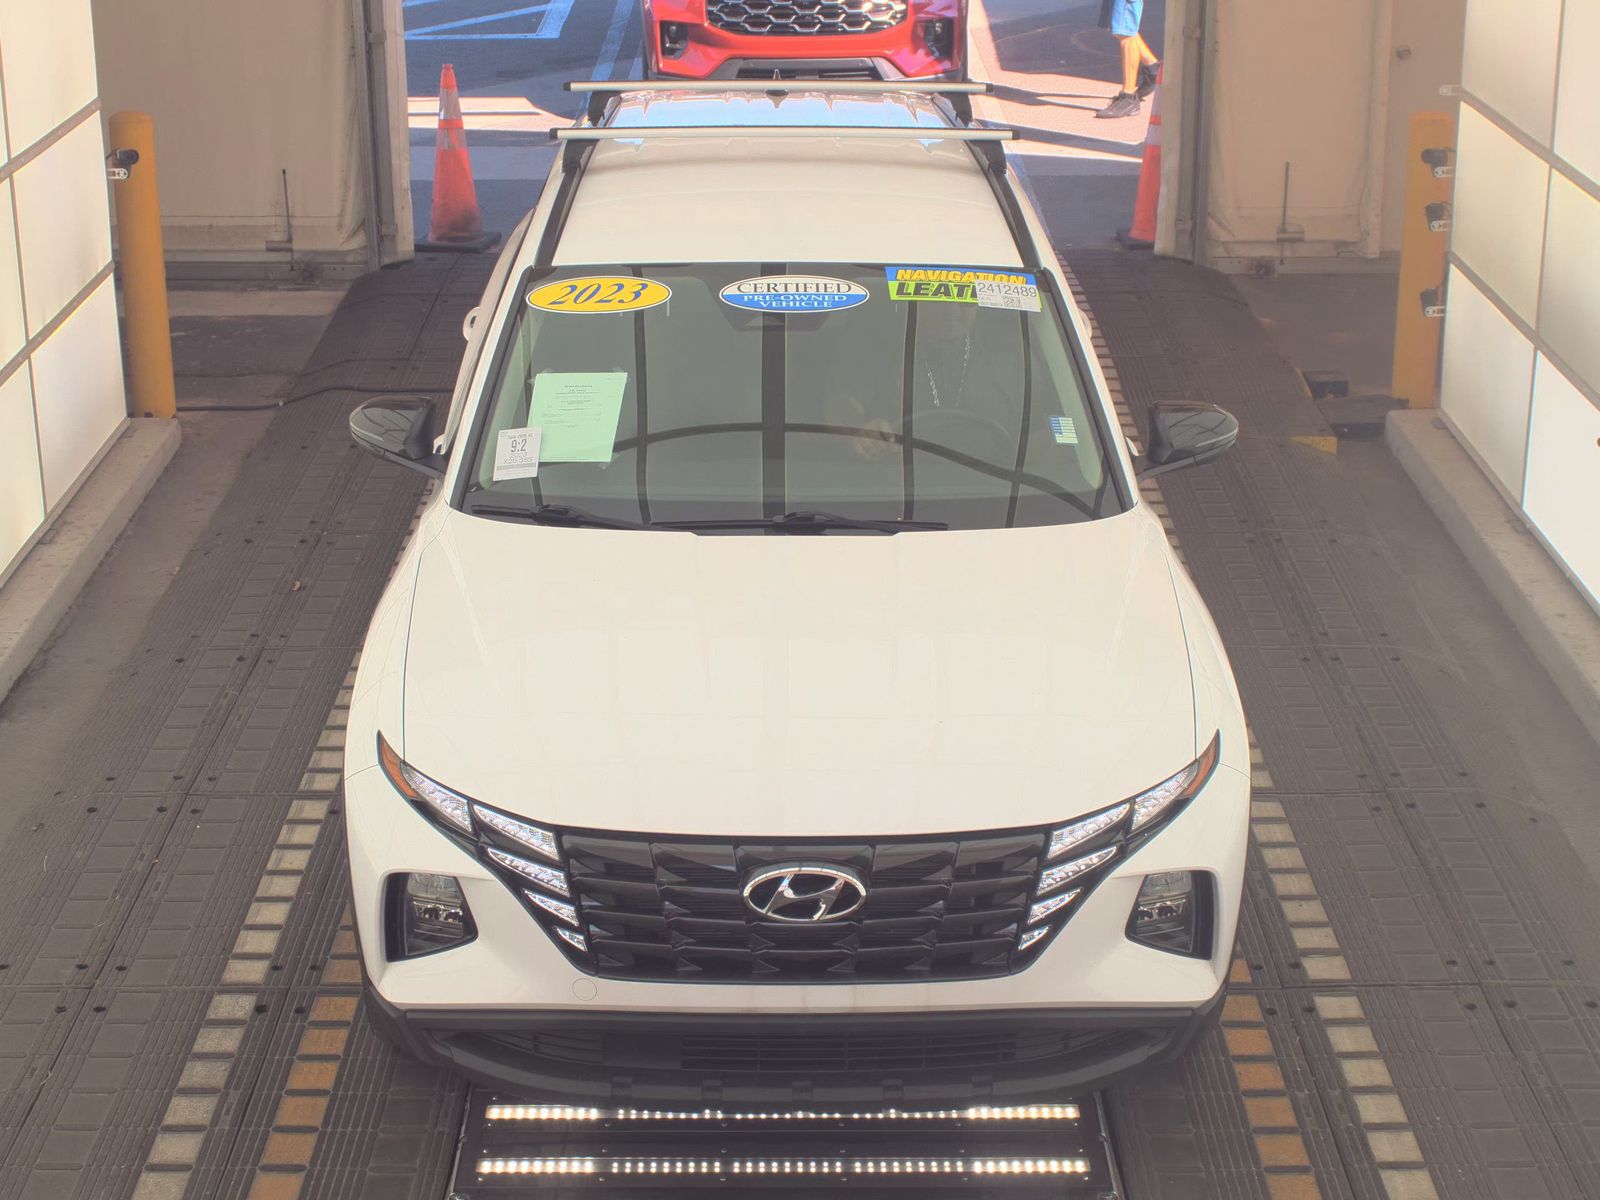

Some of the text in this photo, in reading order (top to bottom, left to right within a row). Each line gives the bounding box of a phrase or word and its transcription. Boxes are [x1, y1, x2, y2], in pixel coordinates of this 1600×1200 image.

[896, 269, 1028, 285] NAVIGATION
[547, 283, 649, 306] 2023
[737, 282, 851, 294] CERTIFIED
[978, 281, 1038, 298] 2412489
[743, 294, 847, 302] PRE-OWNED
